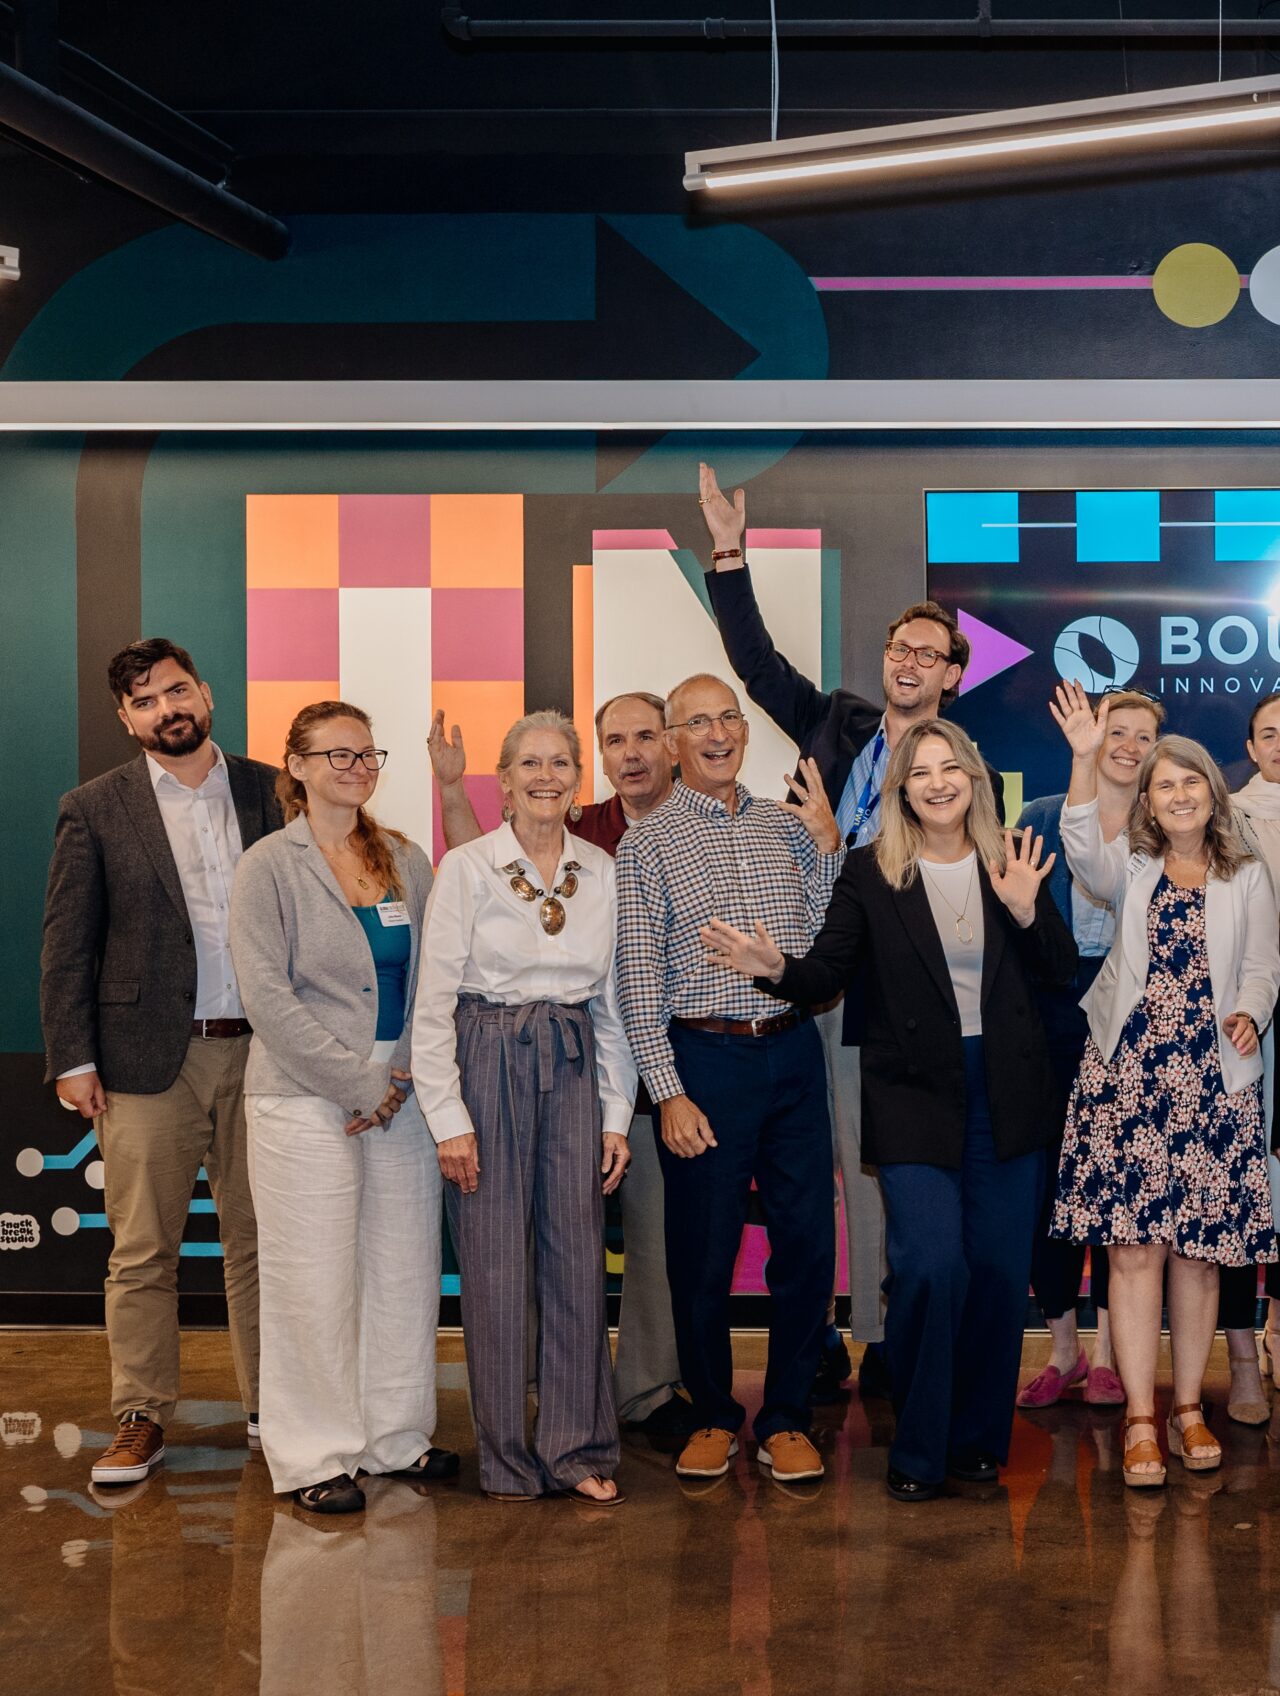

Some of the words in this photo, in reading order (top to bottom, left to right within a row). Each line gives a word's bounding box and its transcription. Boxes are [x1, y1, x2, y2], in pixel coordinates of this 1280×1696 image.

[1, 1219, 32, 1229] snack
[2, 1228, 33, 1236] break
[0, 1235, 35, 1243] studio
